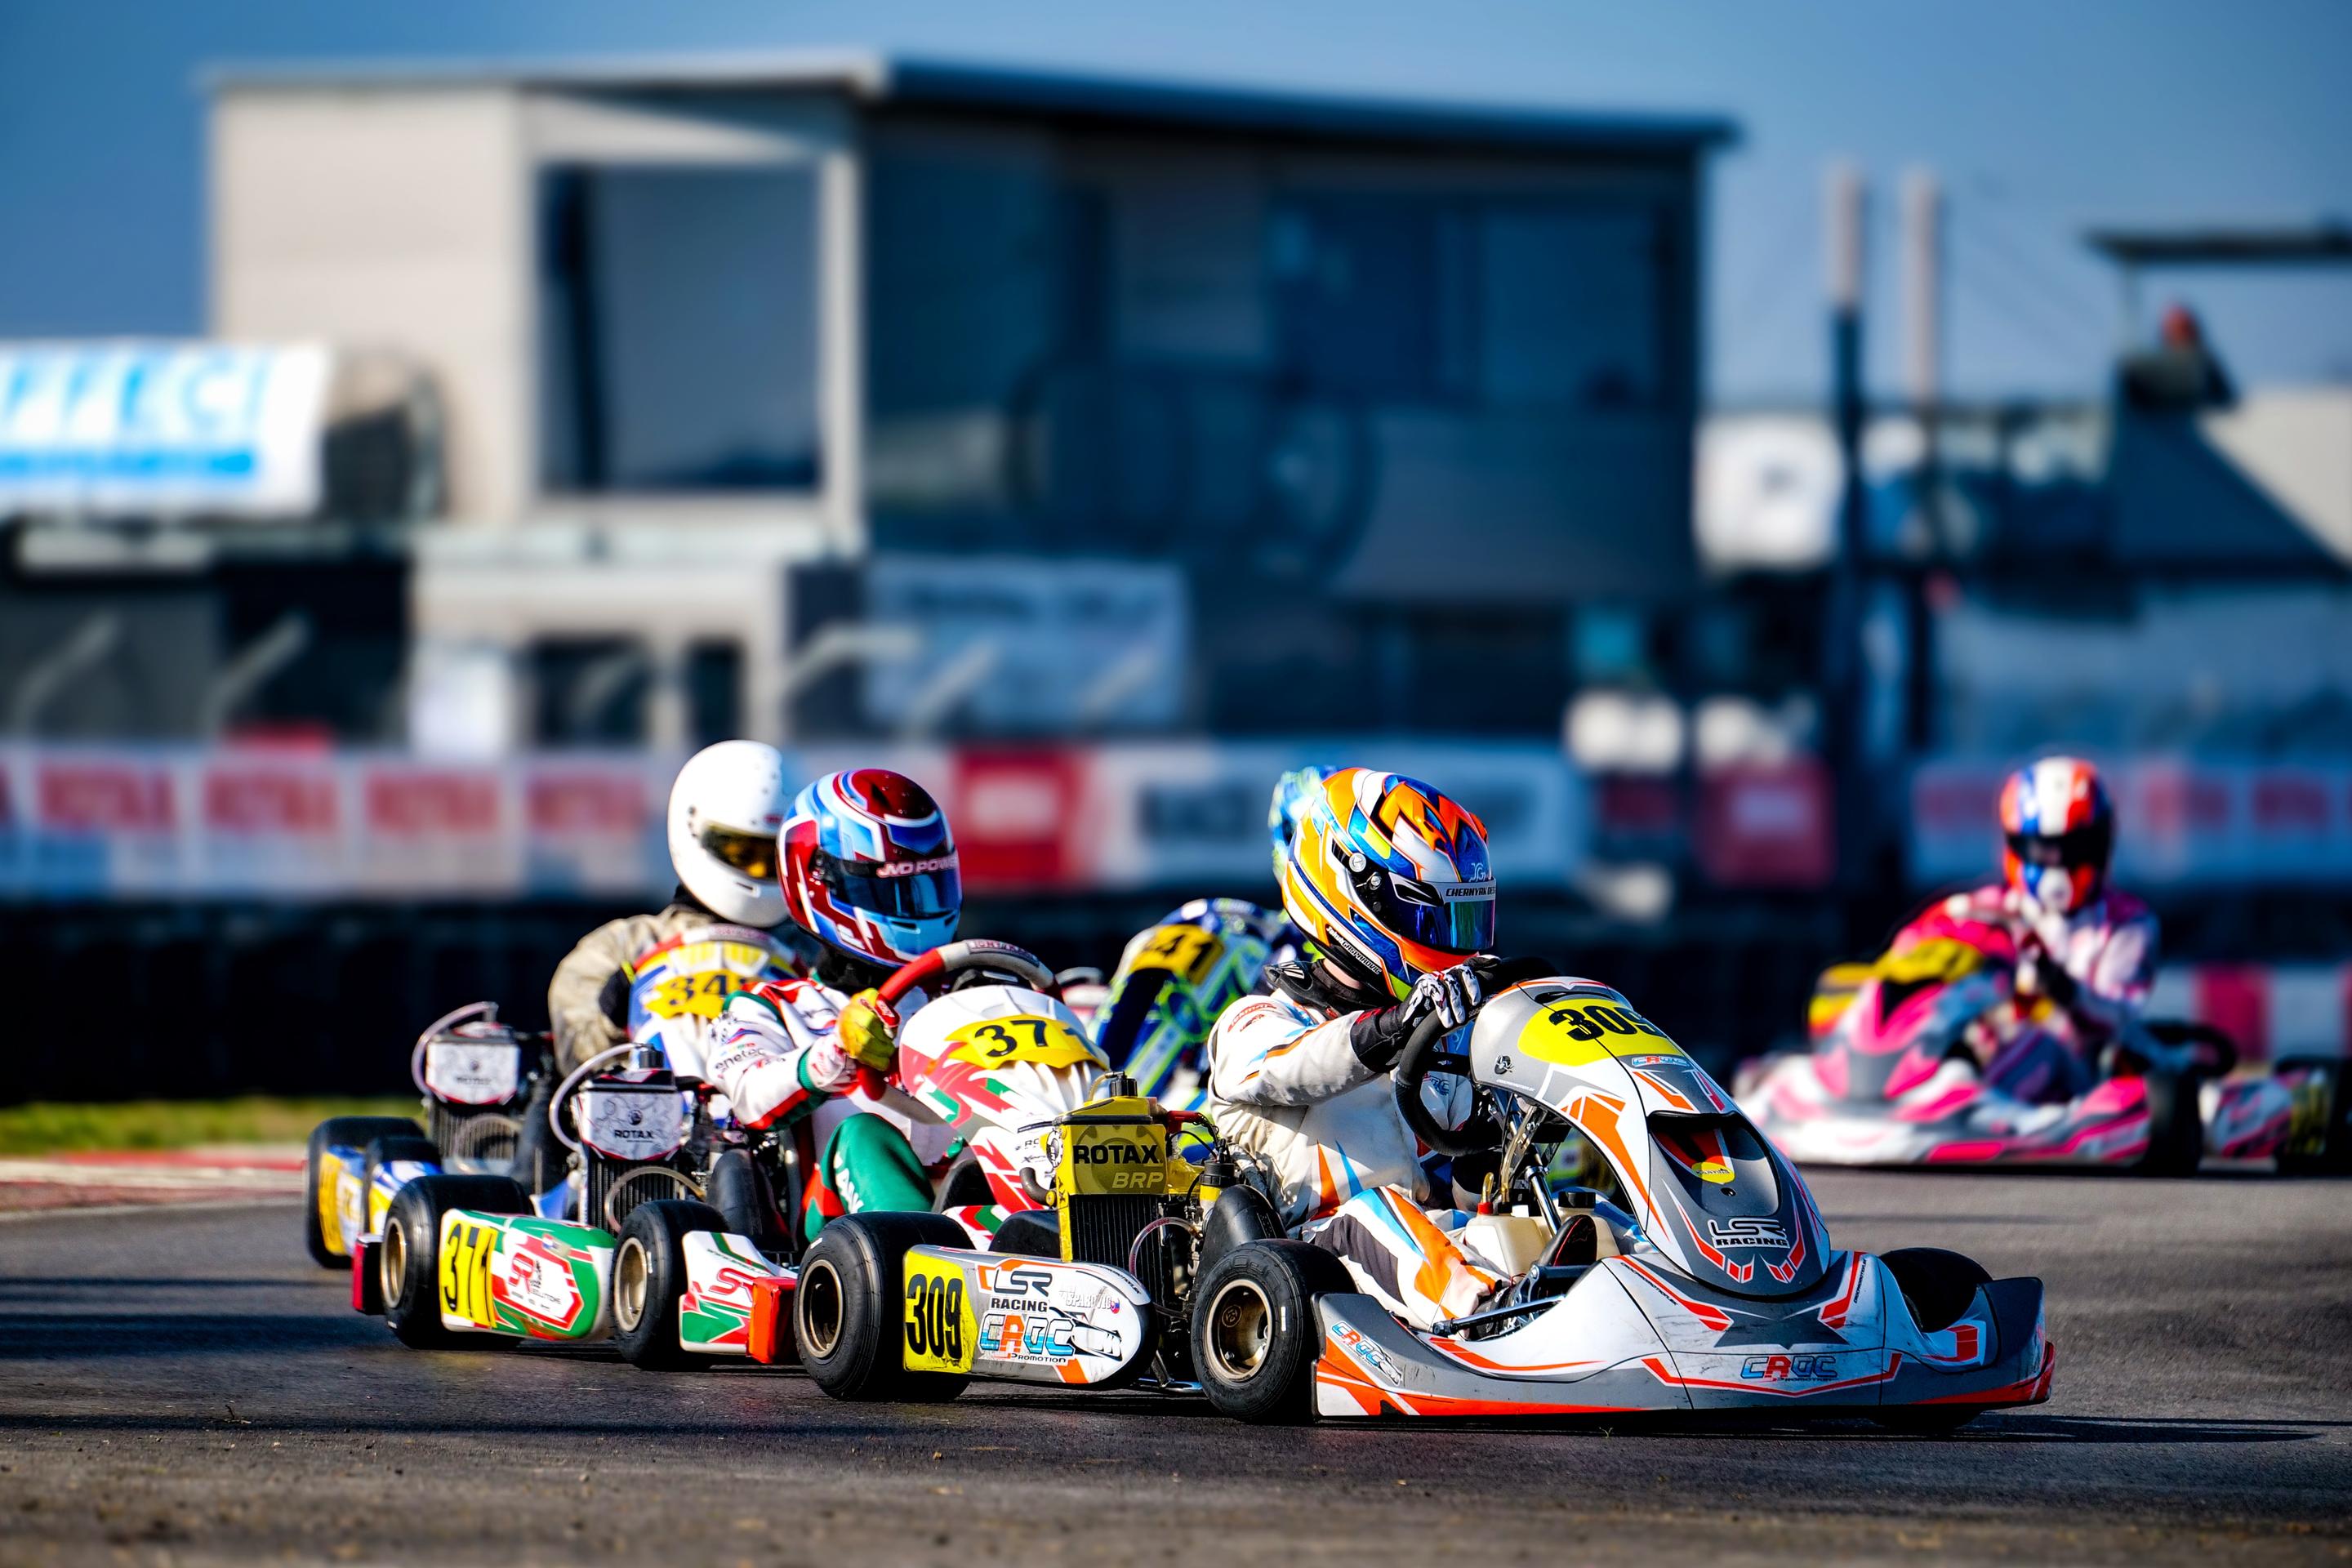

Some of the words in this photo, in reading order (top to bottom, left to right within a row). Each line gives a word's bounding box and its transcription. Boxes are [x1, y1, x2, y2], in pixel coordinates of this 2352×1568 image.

[666, 973, 747, 1007] 34
[613, 1129, 654, 1138] ROTAX
[1073, 1145, 1163, 1165] ROTAX
[1111, 1171, 1165, 1189] BRP
[1714, 1237, 1789, 1247] RACING
[994, 1269, 1053, 1297] LSR
[991, 1298, 1048, 1313] RACING
[906, 1273, 963, 1360] 309
